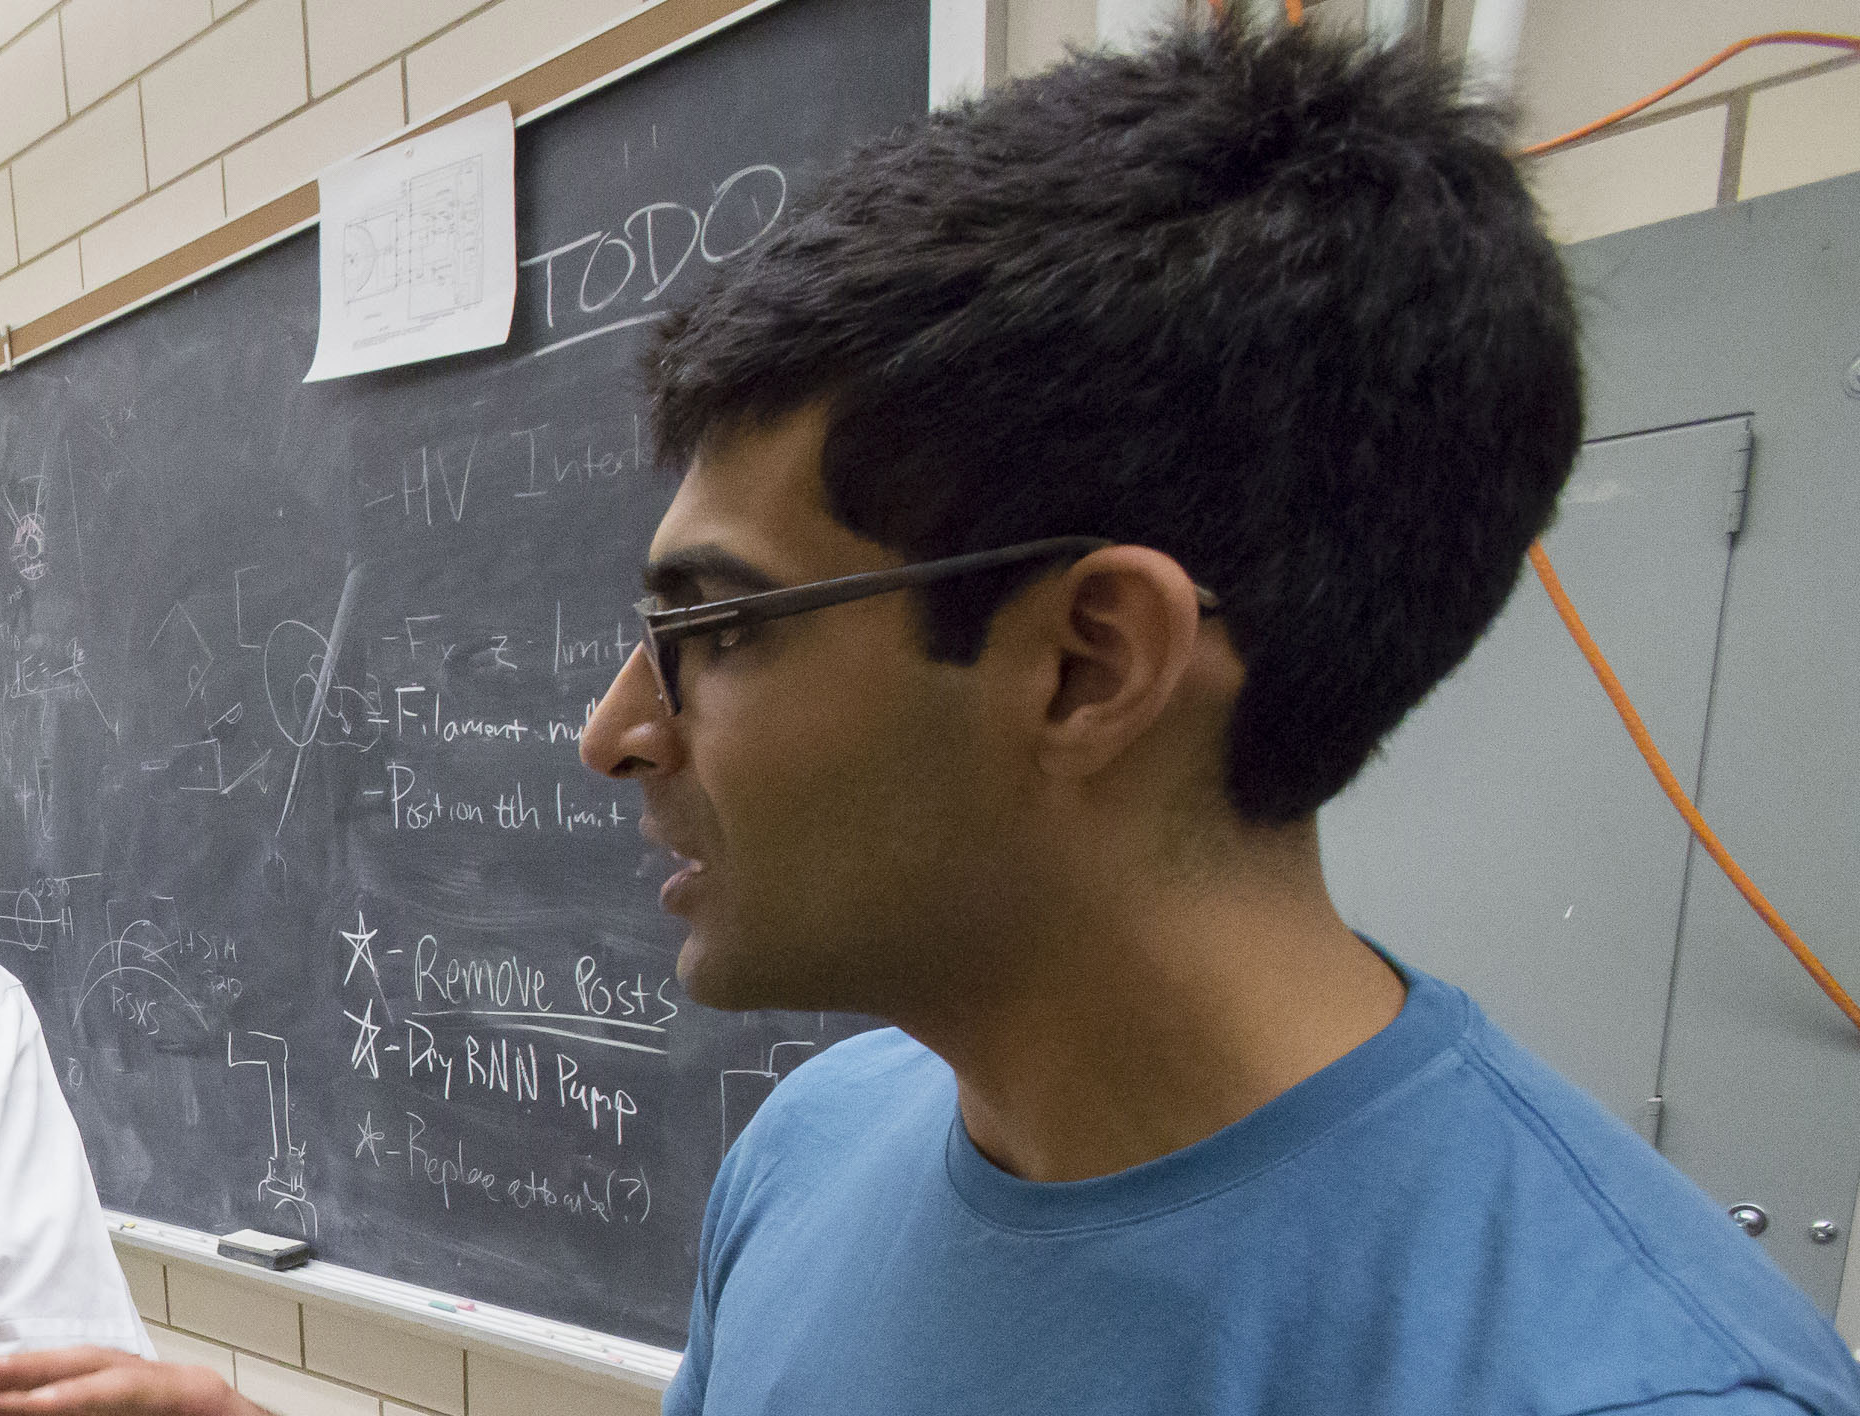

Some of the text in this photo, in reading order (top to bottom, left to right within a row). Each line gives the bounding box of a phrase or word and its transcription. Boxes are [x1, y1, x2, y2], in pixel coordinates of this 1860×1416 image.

[519, 164, 786, 328] TODO
[556, 782, 626, 832] limit
[576, 955, 679, 1025] Posts
[556, 1053, 638, 1146] Pump
